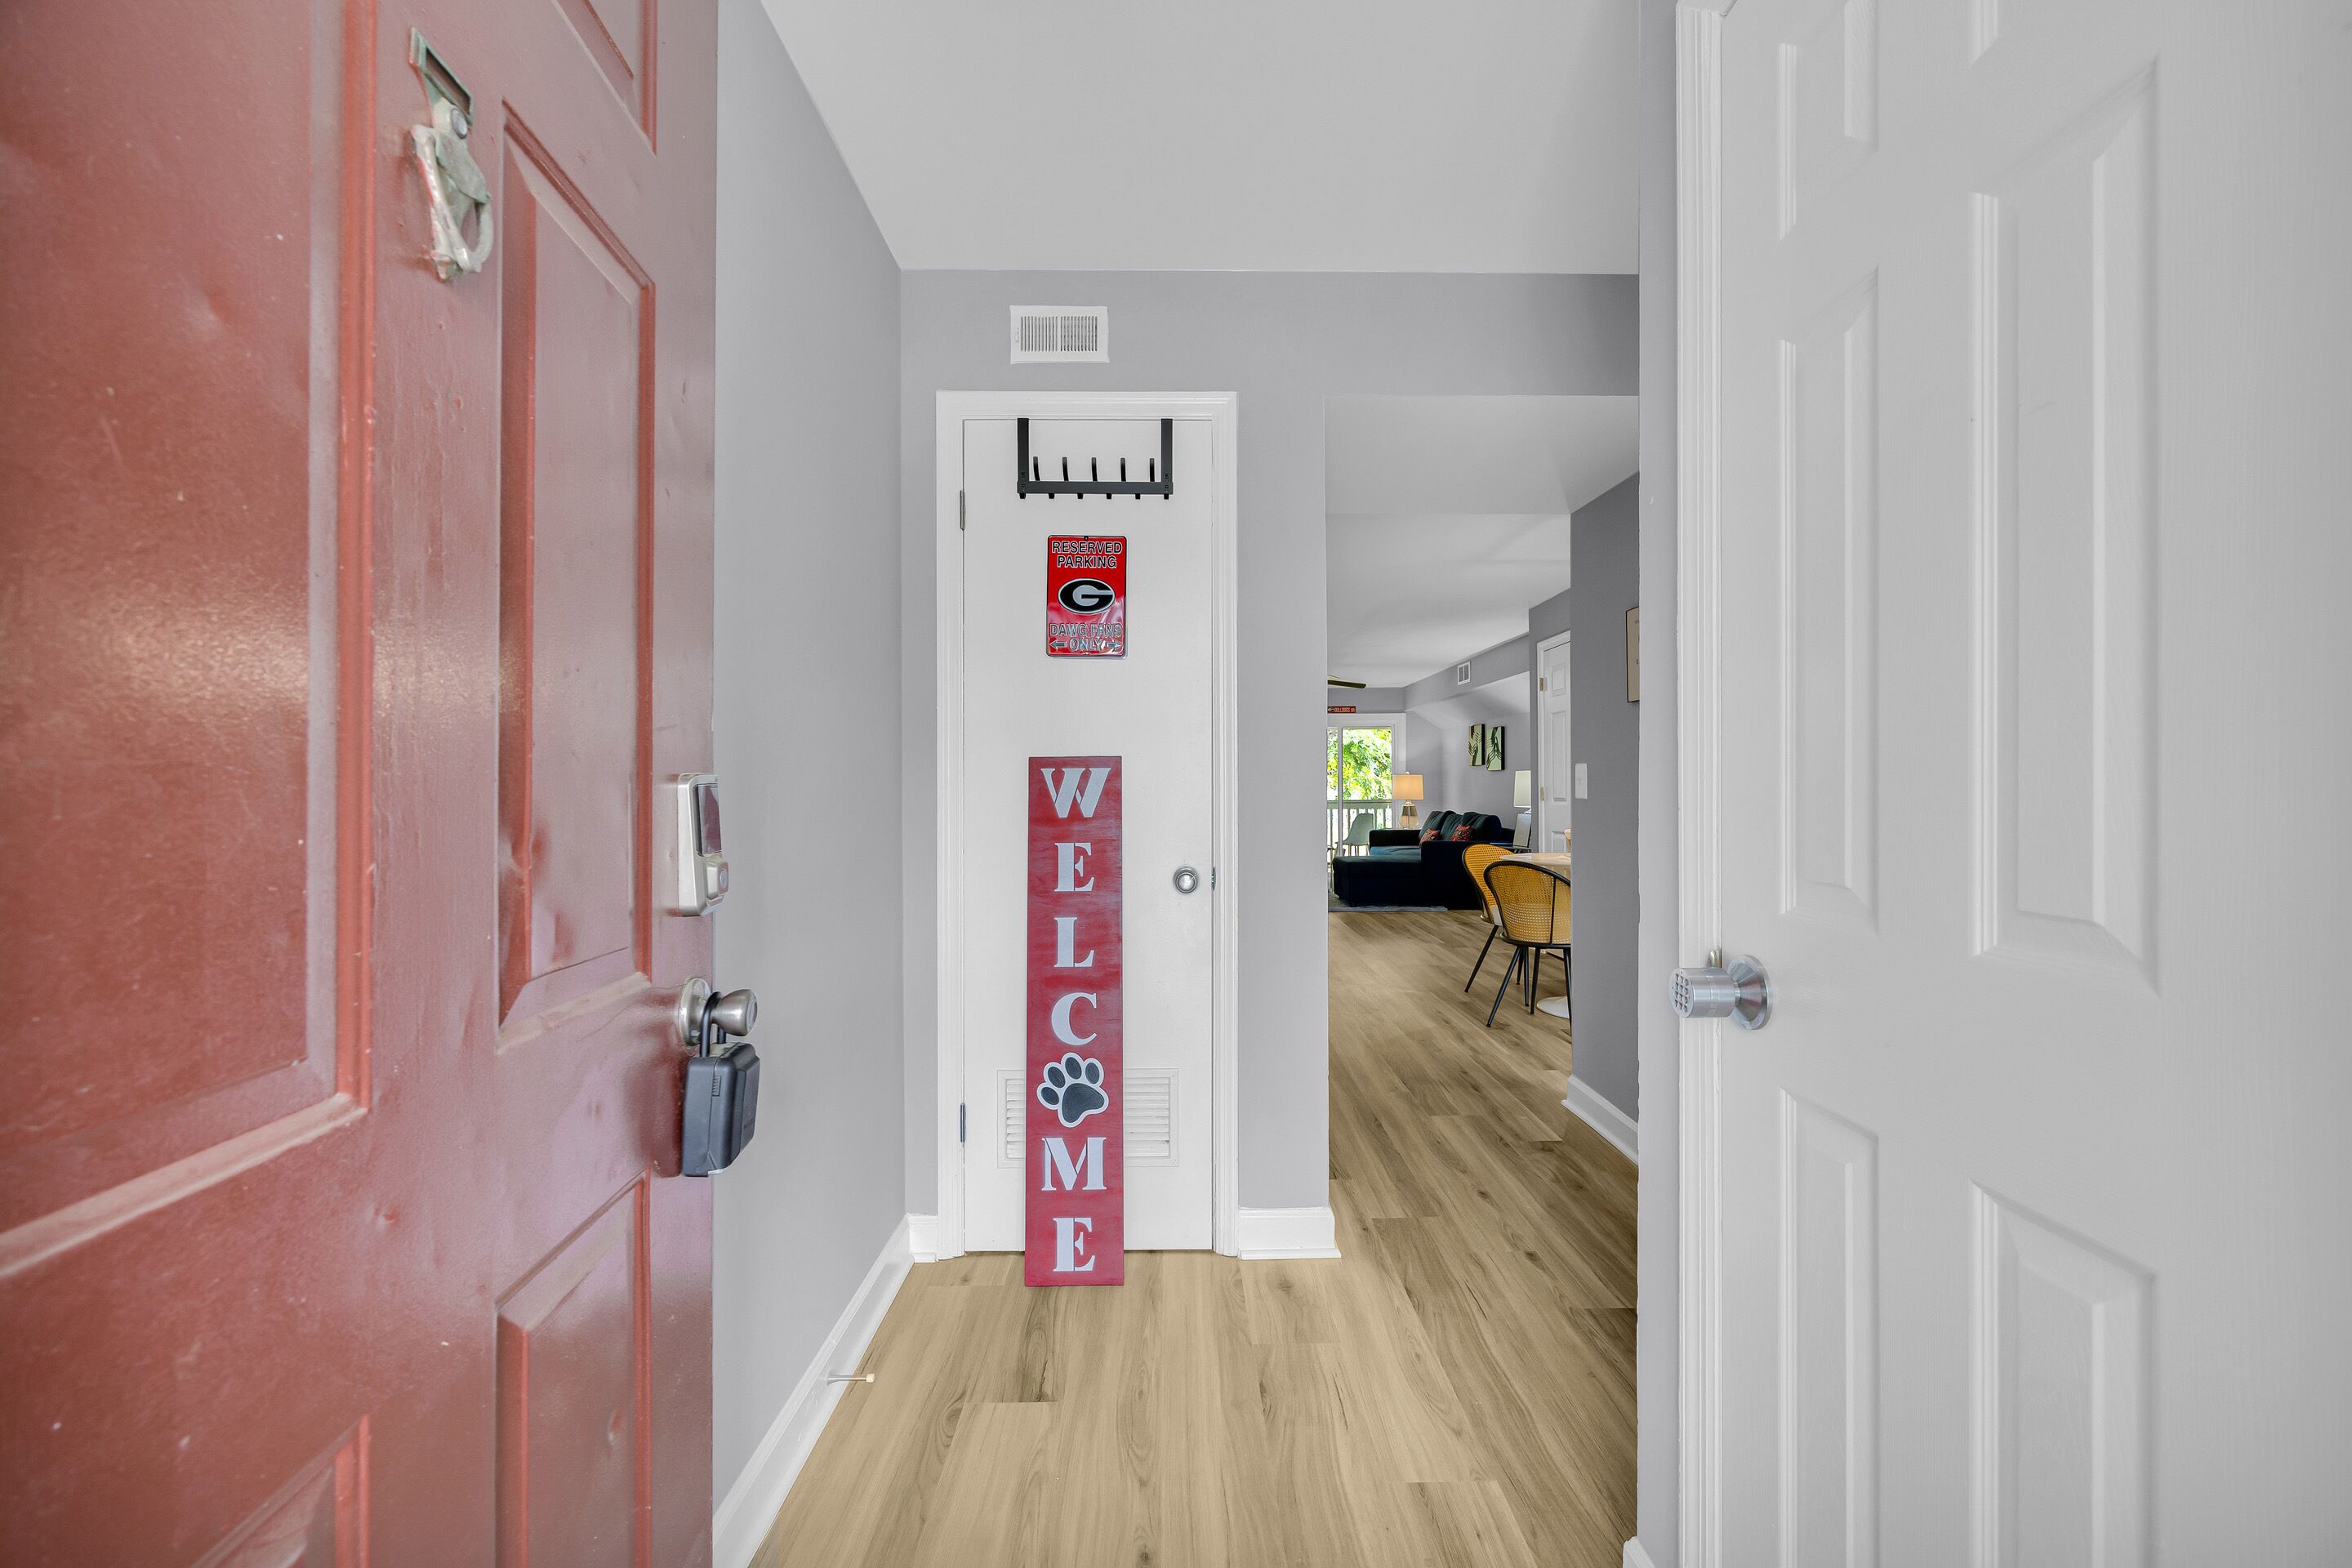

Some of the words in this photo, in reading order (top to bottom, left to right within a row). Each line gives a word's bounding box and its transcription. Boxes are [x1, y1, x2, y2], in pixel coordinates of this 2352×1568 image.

[1052, 541, 1122, 554] RESERVED
[1057, 555, 1117, 568] PARKING
[1058, 577, 1116, 614] G
[1050, 623, 1087, 636] DAWG
[1090, 623, 1122, 636] FANS
[1069, 638, 1103, 651] ONLY
[1040, 767, 1111, 1272] WELCME
